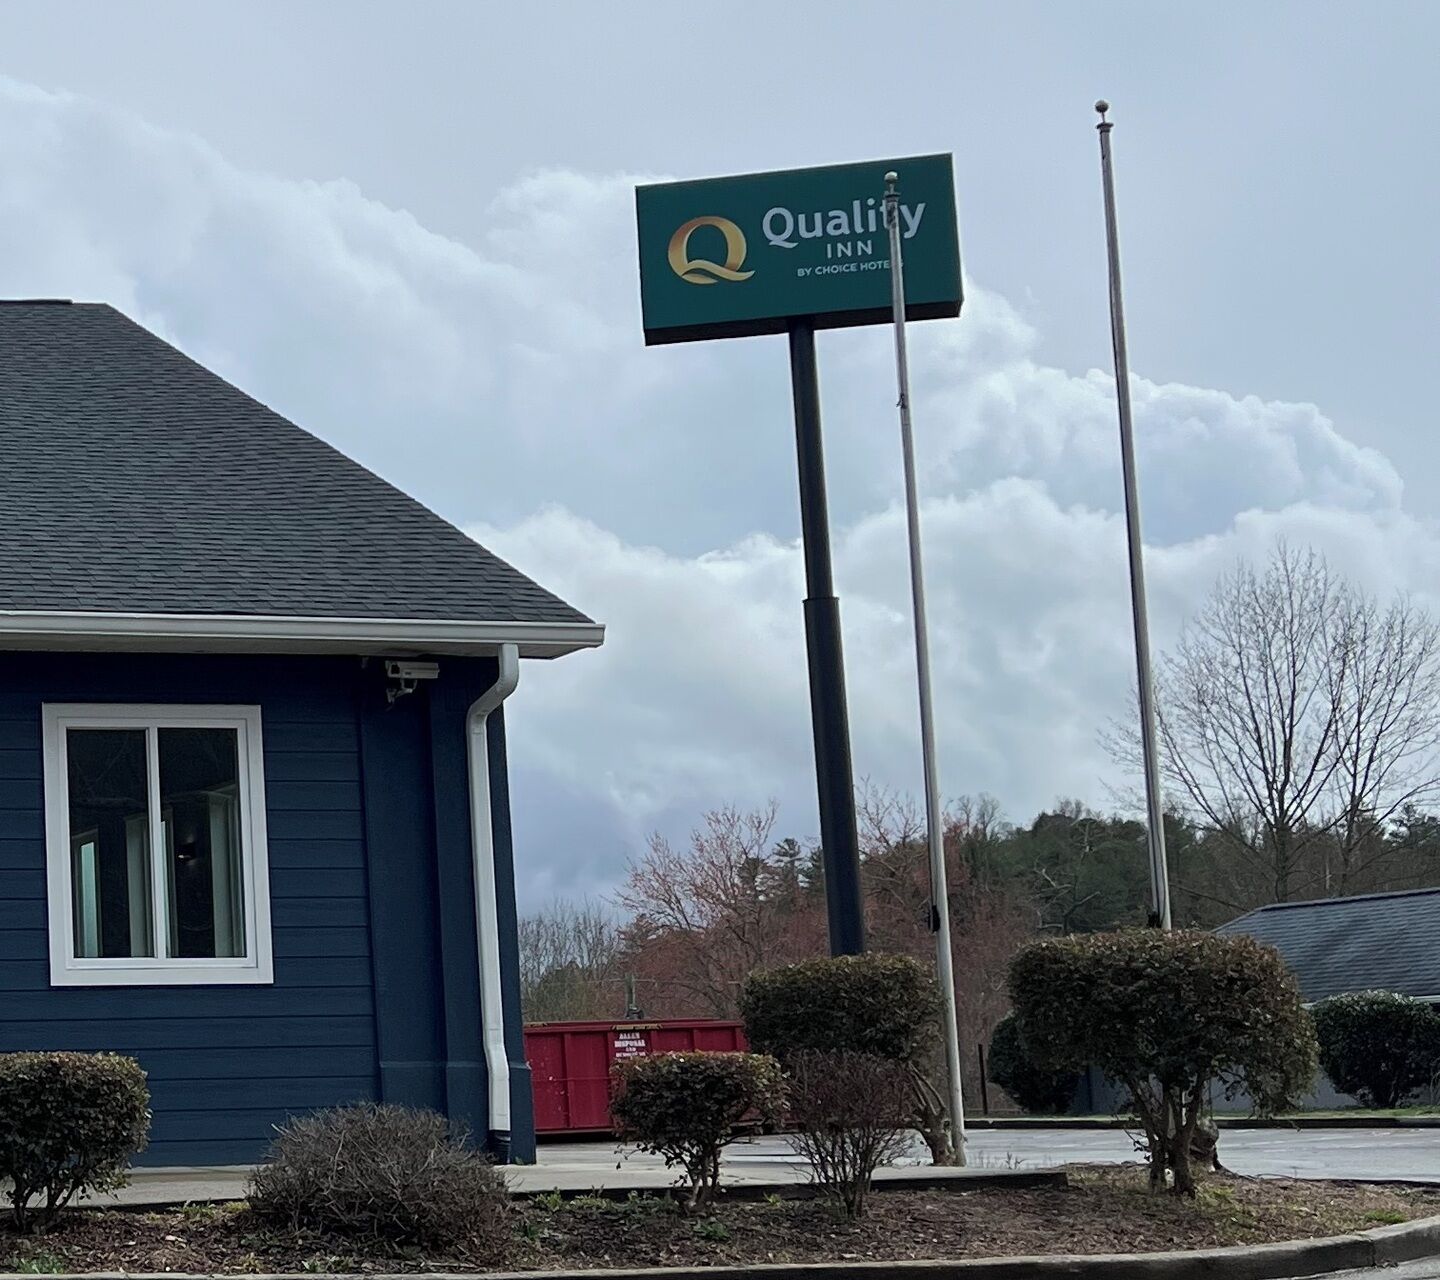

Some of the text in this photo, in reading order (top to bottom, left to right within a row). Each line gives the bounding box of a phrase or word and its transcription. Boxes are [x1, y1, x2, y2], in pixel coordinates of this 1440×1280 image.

[762, 198, 926, 248] Quality
[668, 216, 755, 284] Q
[826, 240, 873, 259] INN
[797, 259, 903, 277] BY CHOICE HOTE
